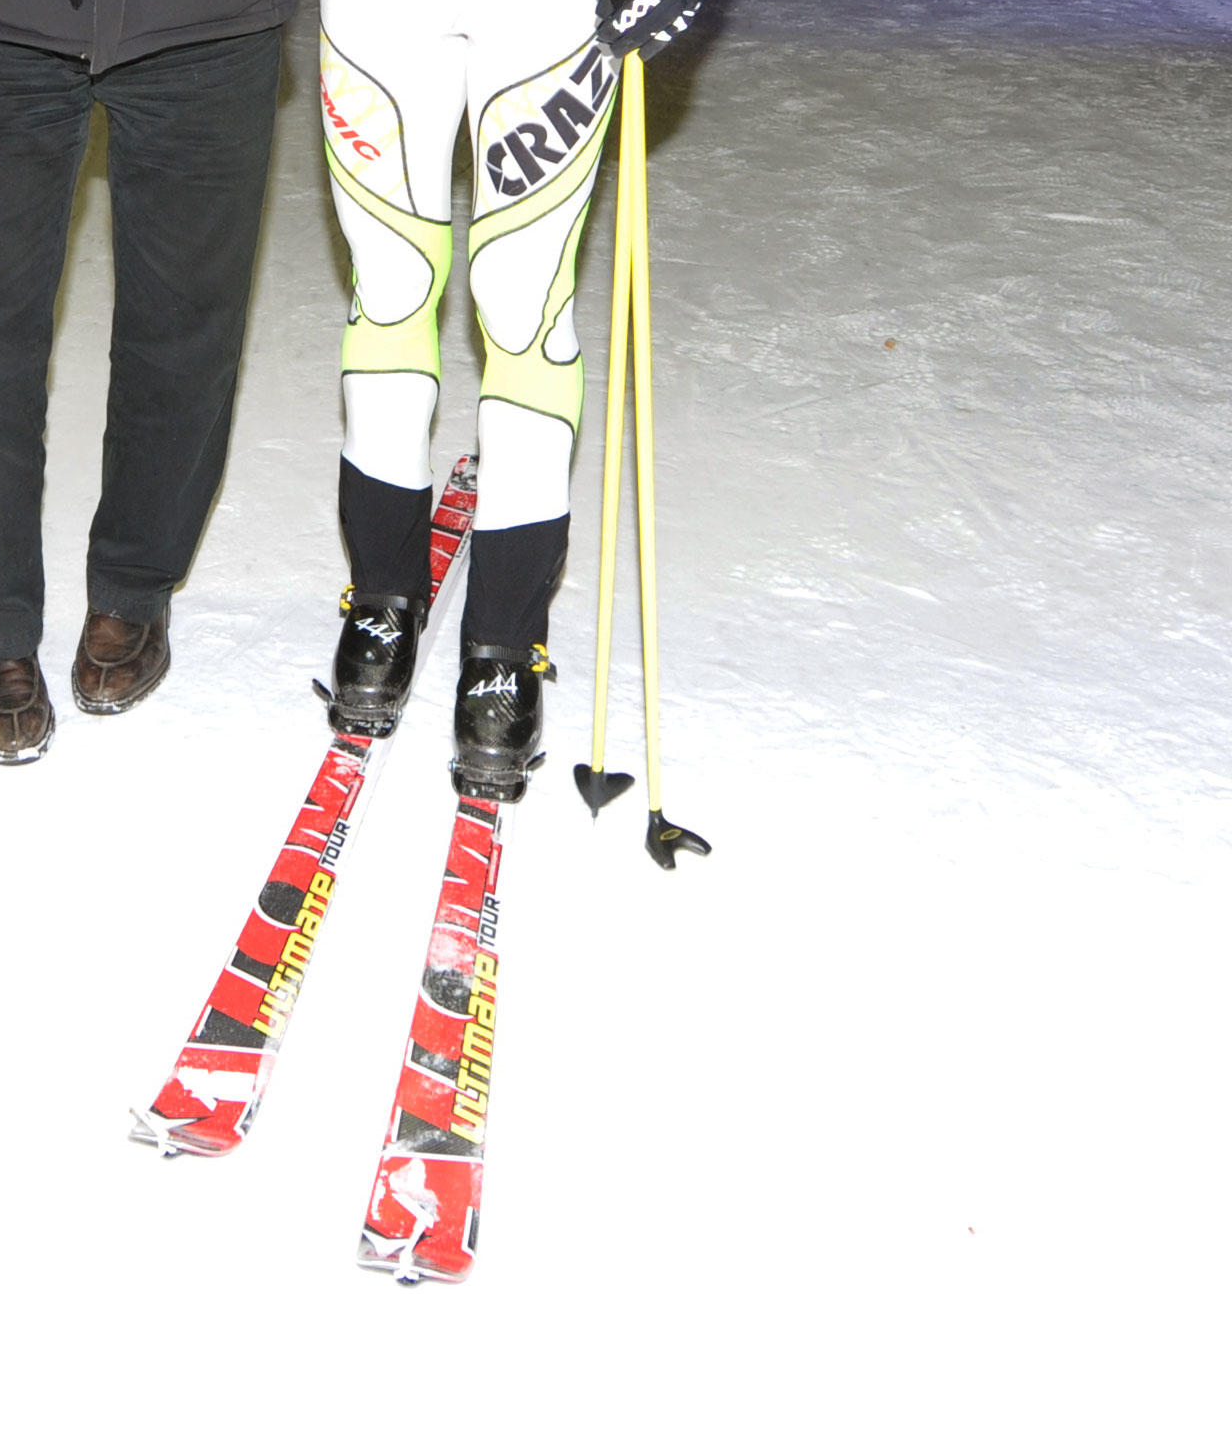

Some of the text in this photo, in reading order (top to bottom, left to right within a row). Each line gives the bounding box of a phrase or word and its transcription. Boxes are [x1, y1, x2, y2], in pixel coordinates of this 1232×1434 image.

[355, 617, 403, 645] 444
[466, 671, 518, 697] 444
[321, 820, 351, 867] TOUR
[478, 896, 501, 948] TOUR
